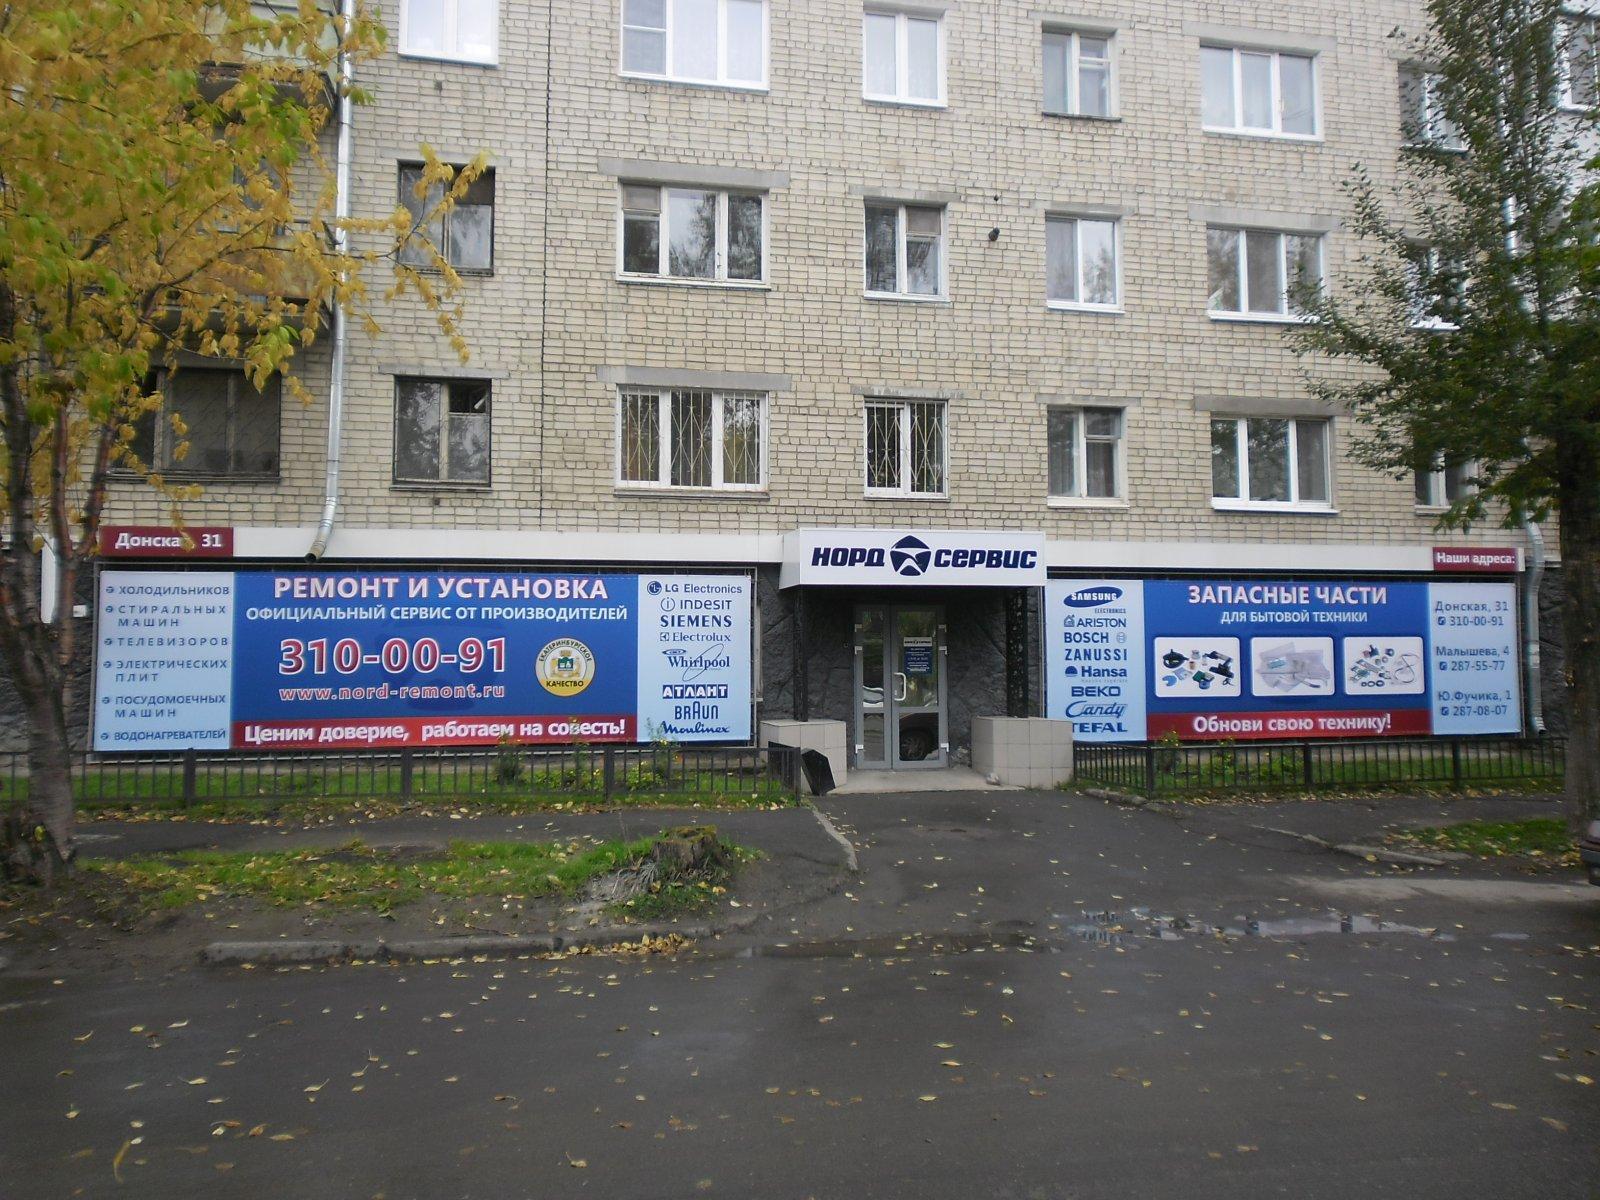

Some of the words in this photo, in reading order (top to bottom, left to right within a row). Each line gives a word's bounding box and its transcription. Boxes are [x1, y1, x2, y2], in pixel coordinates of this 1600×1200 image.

[115, 532, 195, 550] Донска,
[201, 533, 222, 548] 31
[811, 547, 885, 566] НОРД
[934, 549, 1037, 568] СЕРВИС
[1437, 552, 1470, 564] Наши
[1472, 554, 1515, 566] адреса:
[118, 585, 230, 595] ХОЛОДИЛЬНИКОВ
[274, 576, 398, 599] РЕМОНТ
[408, 577, 429, 598] И
[437, 578, 608, 600] УСТАНОВКА
[665, 583, 679, 593] LG
[684, 583, 742, 594] Electronics
[1071, 592, 1117, 600] SAMSUNG
[1188, 585, 1309, 604] ЗАПАСНЫЕ
[1315, 587, 1387, 604] ЧАСТИ
[118, 605, 226, 615] СТИРАЛЬНЫХ
[1435, 601, 1490, 612] Донская,
[1495, 602, 1508, 611] 31
[246, 604, 385, 622] ОФИЦИАЛЬНЫЙ
[390, 605, 451, 621] СЕРВИС
[456, 605, 476, 621] ОТ
[481, 604, 628, 622] ПРОИЗВОДИТЕЛЕЙ
[1221, 611, 1246, 625] ДЛЯ
[1250, 610, 1310, 623] БЫТОВОЙ
[1313, 611, 1368, 622] ТЕХНИКИ
[118, 618, 180, 627] МАШИН
[660, 615, 732, 627] SIEMENS
[1076, 618, 1126, 627] ARISTON
[1450, 616, 1504, 626] 310-00-91
[117, 637, 228, 646] ТЕЛЕВИЗОРОВ
[673, 632, 731, 642] Electrolux
[1064, 632, 1109, 643] BOSCH
[278, 636, 507, 676] 310-00-91
[1065, 649, 1127, 661] ZANUSSI
[1436, 646, 1500, 657] Малышева,
[1503, 646, 1509, 656] 4
[117, 660, 227, 669] ЭЛЕКТРИЧЕСКИХ
[668, 656, 730, 671] Whirlpool
[1451, 661, 1505, 671] 287-55-77
[1081, 666, 1127, 677] Hansa
[115, 673, 158, 682] ПЛИТ
[545, 680, 584, 688] КАЧЕСТВО
[278, 682, 505, 701] www.nord-remont.ru
[662, 684, 728, 699] АТЛАНТ
[1071, 686, 1121, 696] BEKO
[1438, 691, 1504, 702] Ю.Фучика,
[1506, 691, 1511, 700] 1
[115, 695, 226, 705] ПОСУДОМОЕЧНЫХ
[114, 708, 176, 718] МАШИН
[674, 701, 719, 720] BRAUN
[1065, 701, 1125, 719] Candy
[1453, 705, 1508, 716] 287-08-07
[660, 721, 730, 734] Moulinex
[1194, 716, 1262, 732] Обнови
[1268, 718, 1313, 730] свою
[1319, 714, 1392, 733] технику!
[114, 729, 226, 741] ВОДОНАГРЕВАТЕЛЕЙ
[244, 725, 313, 743] Ценим
[318, 724, 408, 743] доверие,
[422, 720, 514, 741] работаем
[520, 722, 543, 735] на
[548, 719, 626, 735] совесть!
